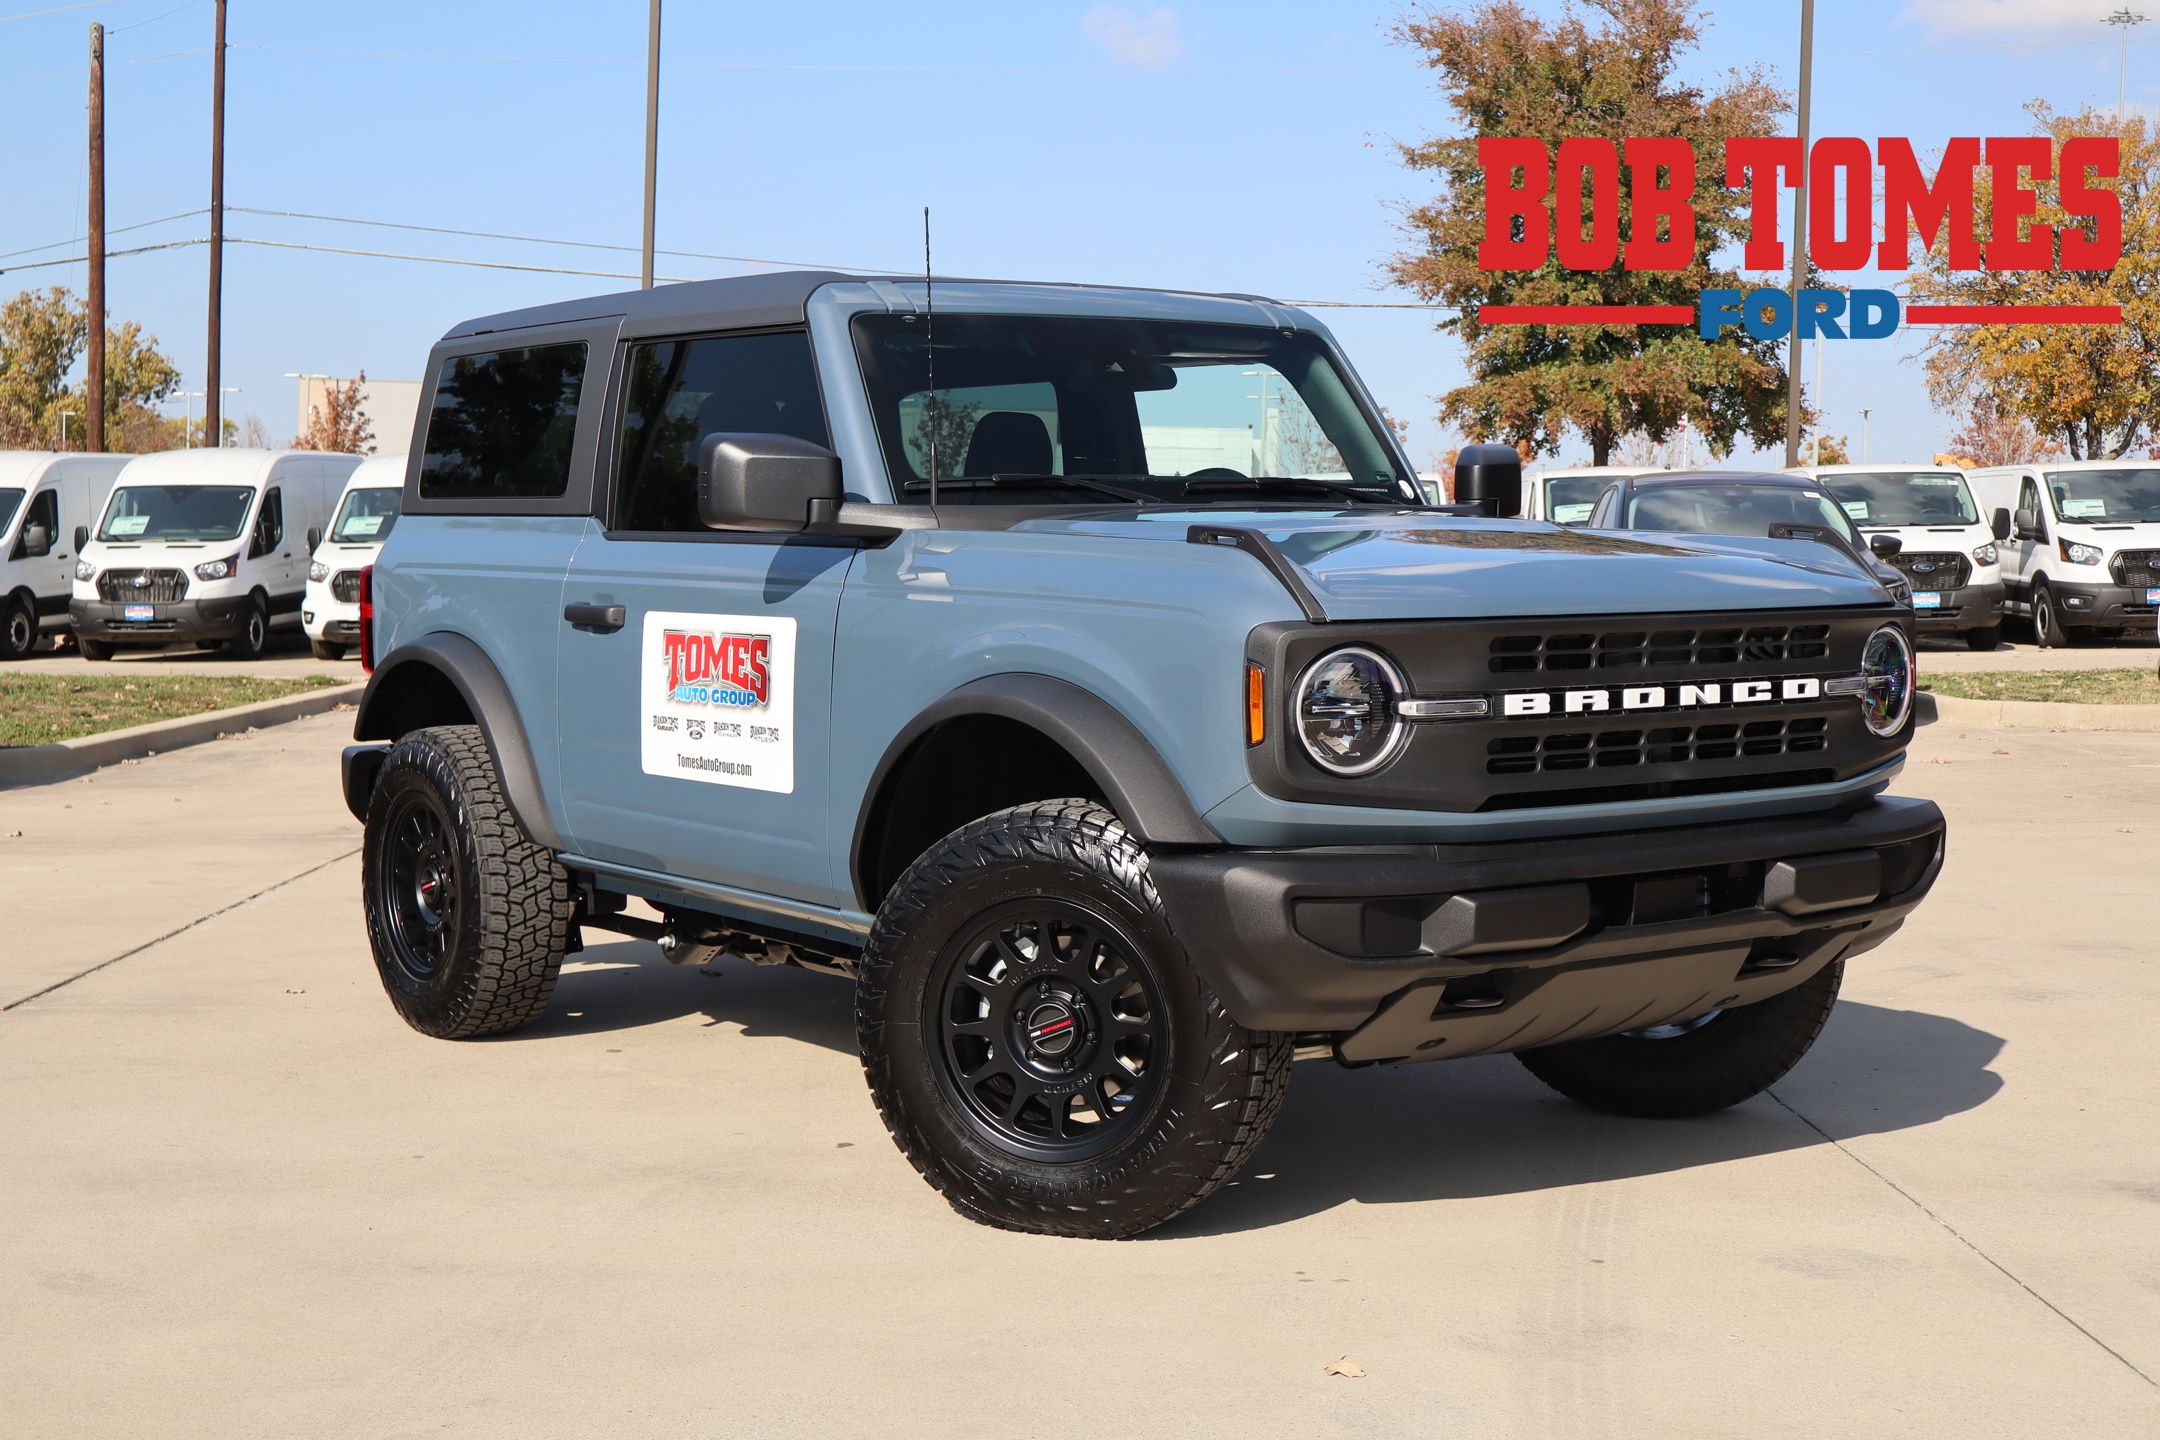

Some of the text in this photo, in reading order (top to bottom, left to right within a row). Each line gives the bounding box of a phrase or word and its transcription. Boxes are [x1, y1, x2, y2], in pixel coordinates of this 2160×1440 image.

[664, 630, 770, 704] TOMES
[675, 687, 757, 706] AUTO GROUP
[1505, 679, 1819, 715] BRONCO
[677, 753, 752, 777] TomesAutoGroup.com
